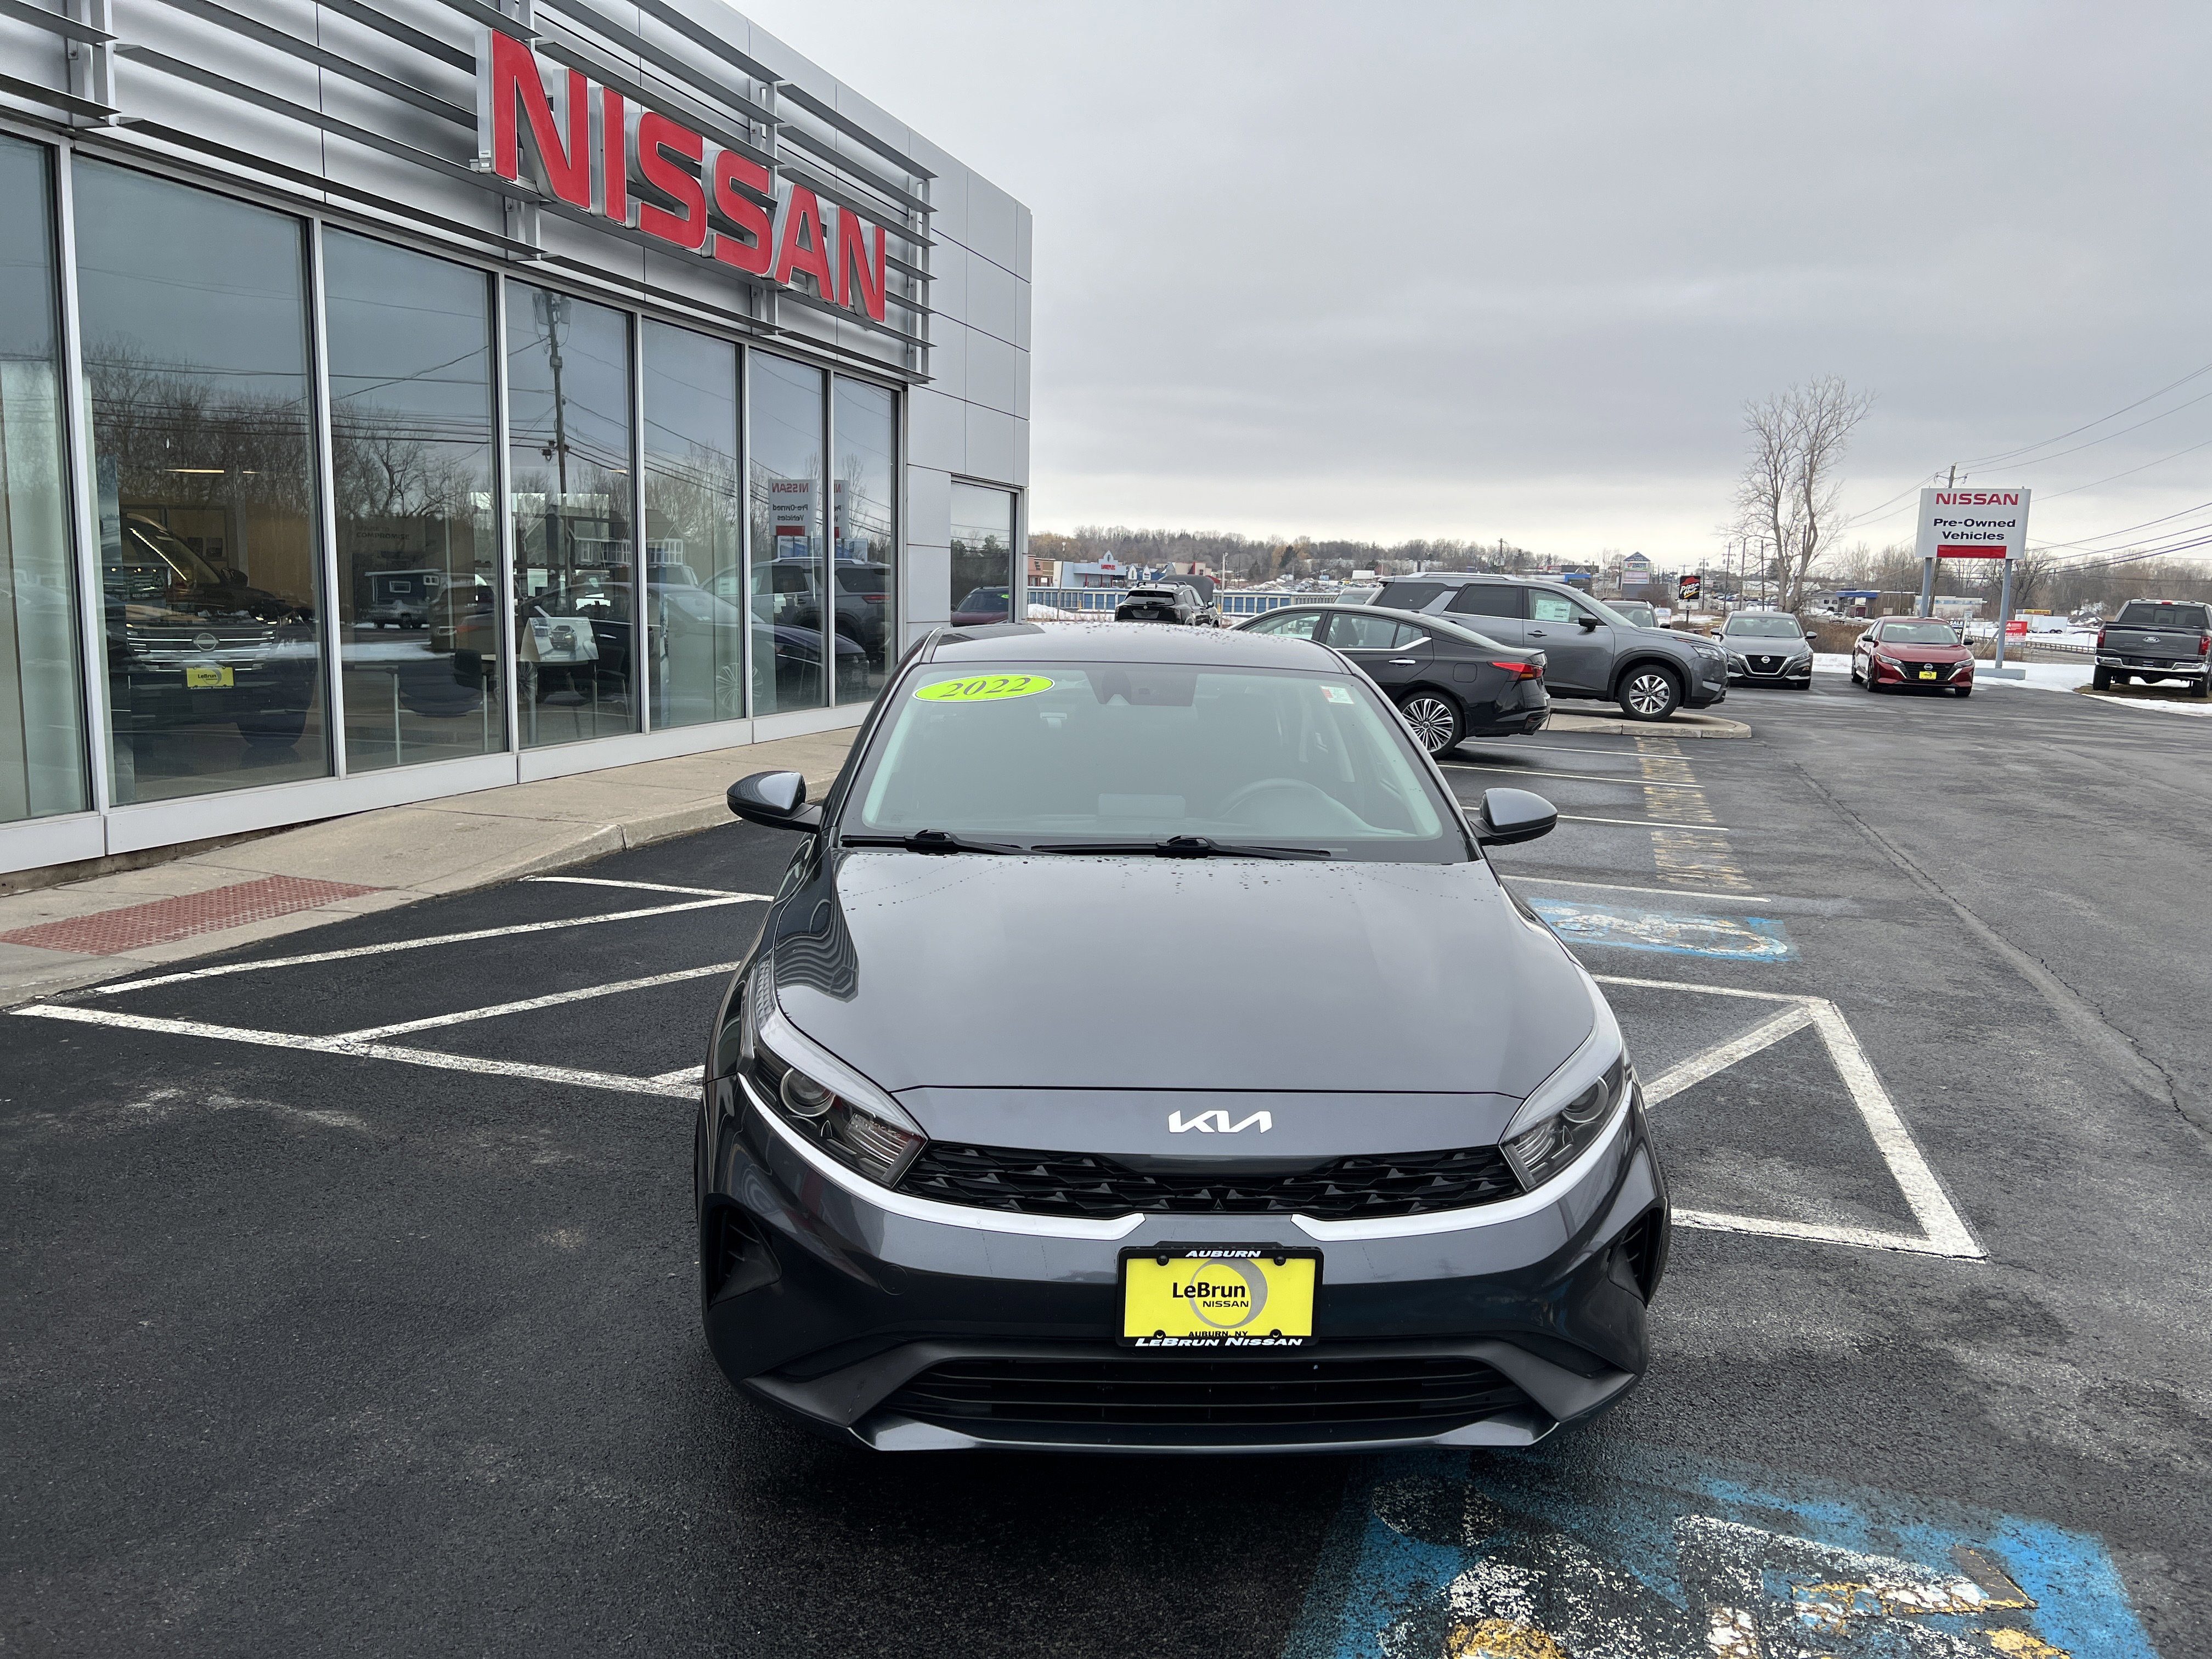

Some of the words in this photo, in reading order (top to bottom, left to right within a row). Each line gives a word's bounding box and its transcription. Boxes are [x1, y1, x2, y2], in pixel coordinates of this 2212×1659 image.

[490, 27, 886, 323] NISSAN
[1936, 493, 2019, 505] NISSAN
[1933, 518, 2016, 528] Pre-Owned
[356, 532, 410, 540] COMPROMISE
[1942, 531, 2005, 540] Vehicles
[1680, 583, 1700, 595] Pizza
[1684, 588, 1698, 596] Hut
[938, 677, 1031, 698] 2022
[1172, 1282, 1245, 1298] LeBrun
[1224, 1337, 1303, 1346] NISSAN
